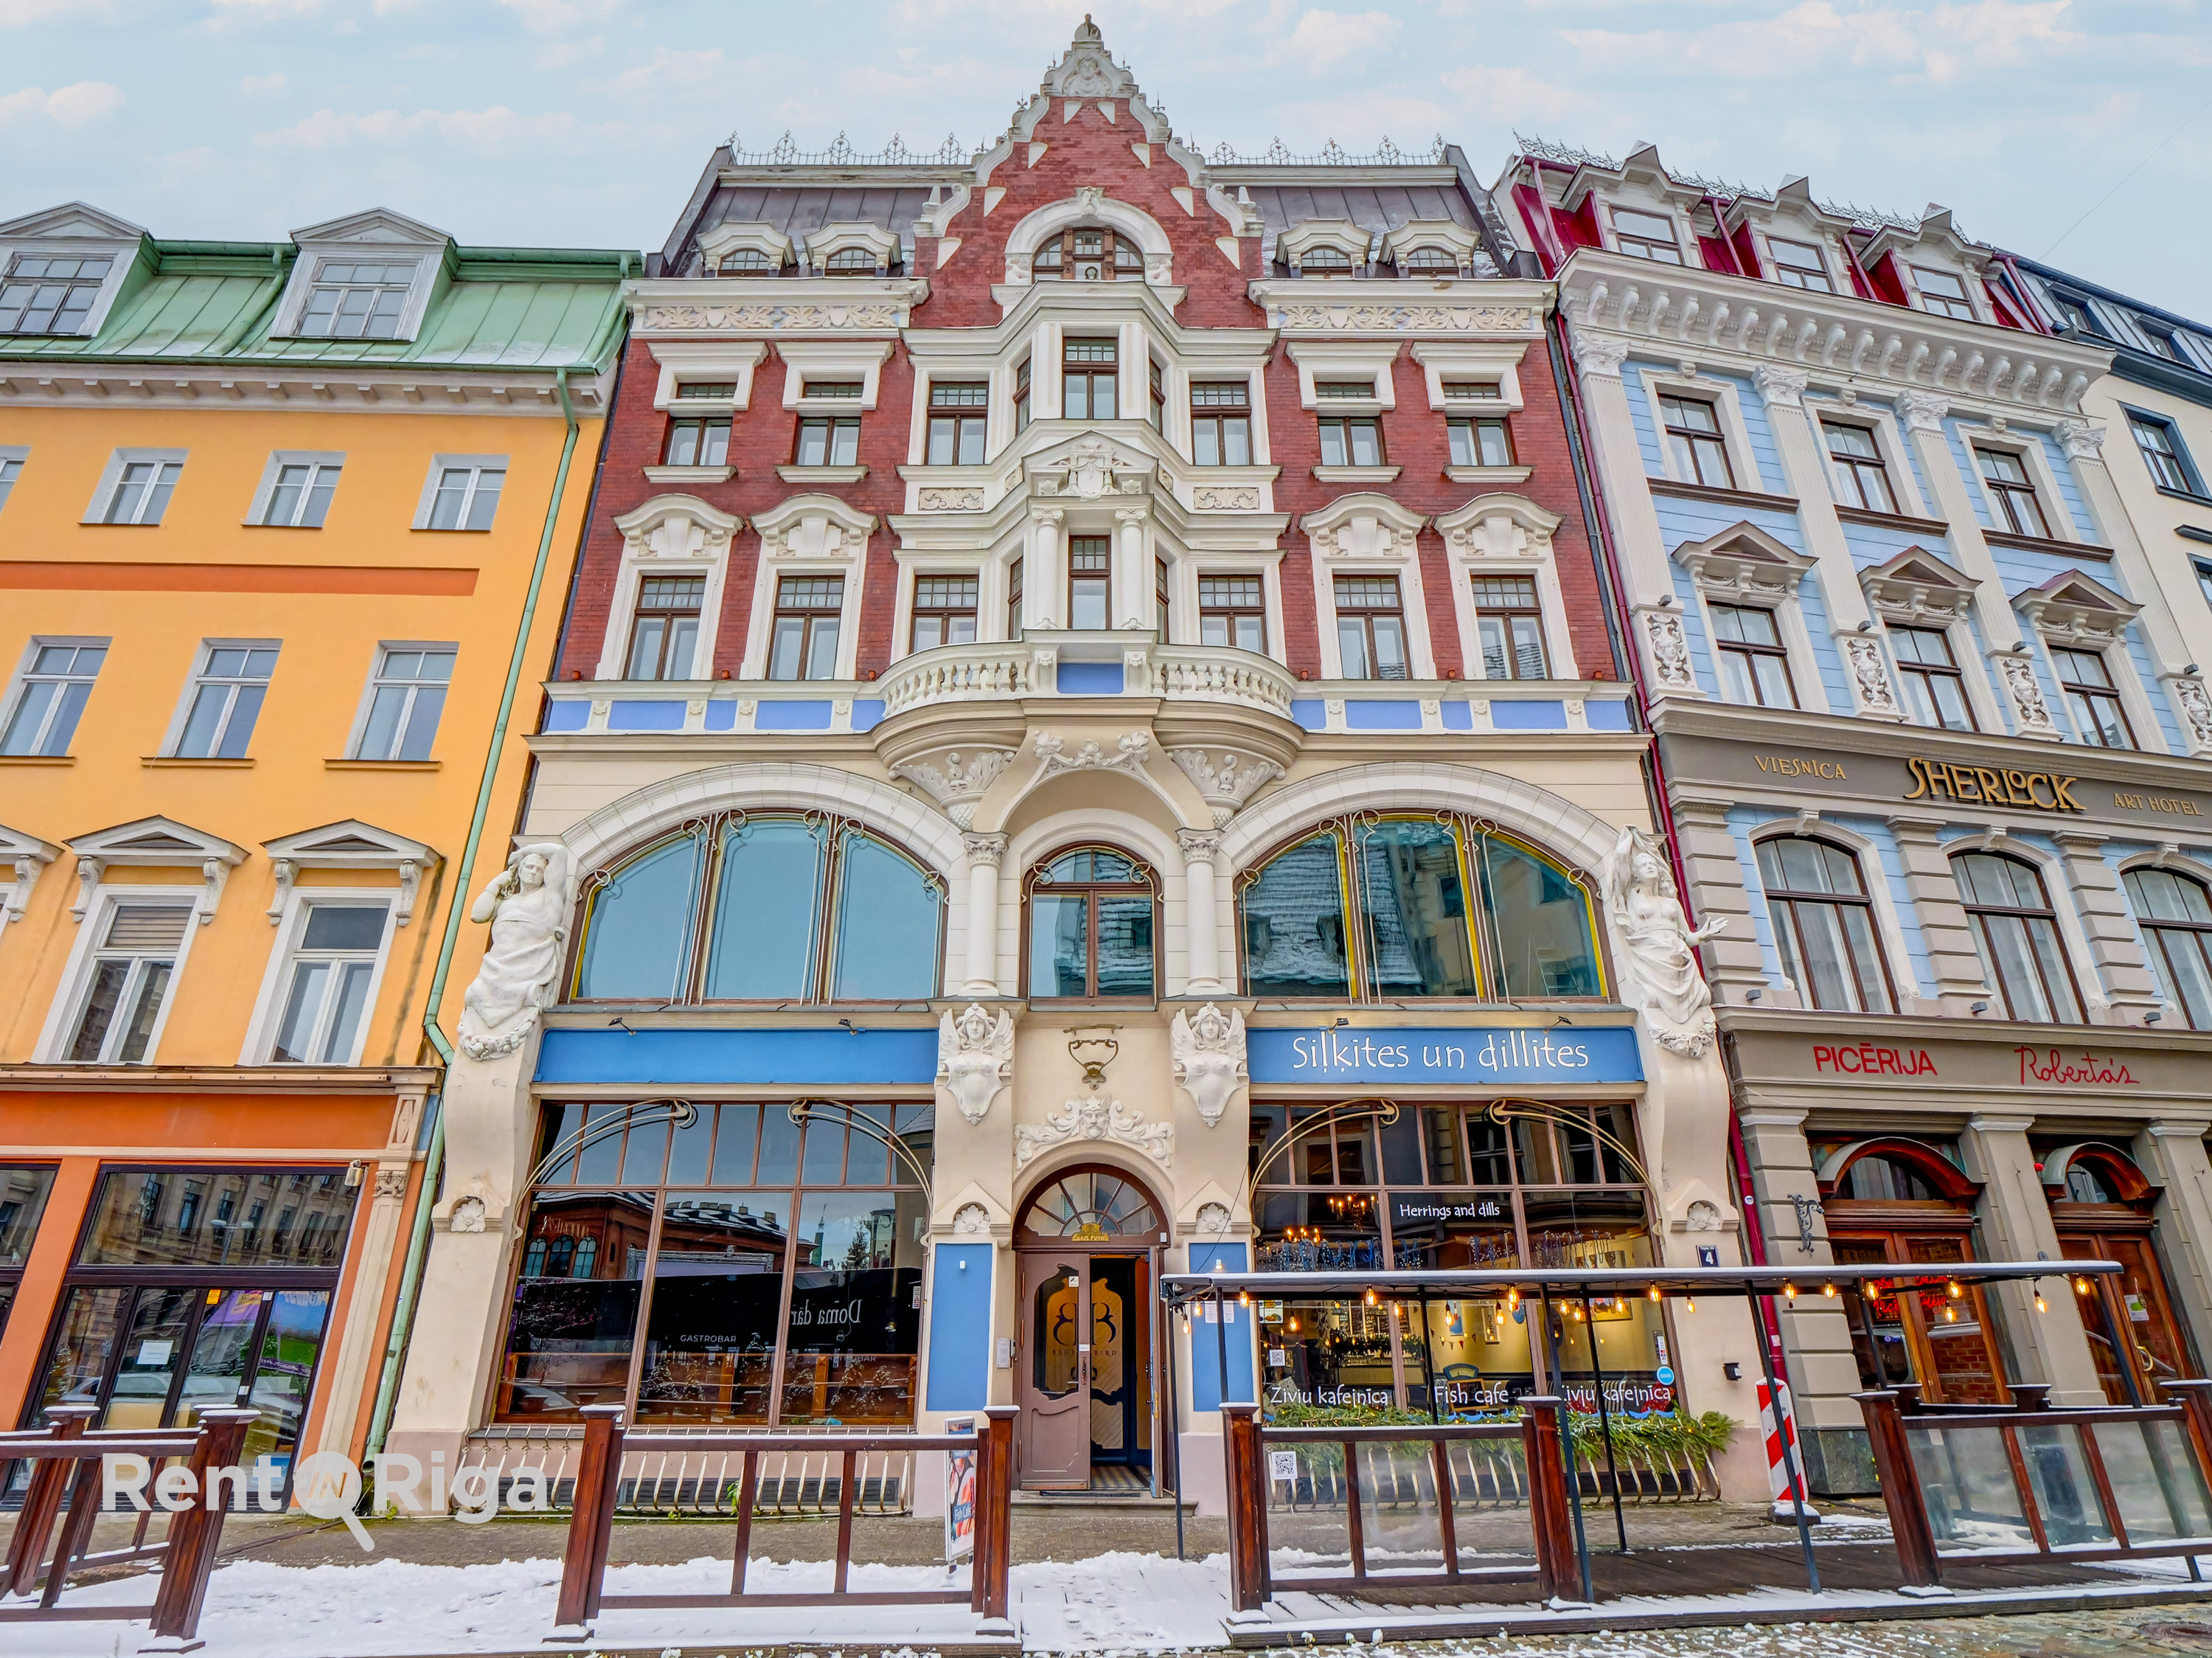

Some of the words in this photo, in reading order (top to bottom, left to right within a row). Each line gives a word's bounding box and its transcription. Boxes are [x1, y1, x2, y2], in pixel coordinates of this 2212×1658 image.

[1904, 756, 2087, 811] SHERLOCK
[2114, 793, 2143, 810] ART
[2146, 797, 2205, 816] HOTEL
[1422, 1045, 1466, 1069] un
[1478, 1030, 1590, 1072] dillites
[1813, 1042, 1938, 1076] PICĒRIJA
[1399, 1204, 1452, 1221] Herrings
[1454, 1202, 1475, 1218] and
[1478, 1201, 1500, 1218] dills
[1705, 1251, 1714, 1265] 4
[680, 1333, 737, 1343] GASTROBAR
[1318, 1383, 1388, 1408] kafejnīca
[1435, 1382, 1468, 1404] Fish
[1475, 1381, 1509, 1406] cafe
[1562, 1385, 1596, 1407] ivju
